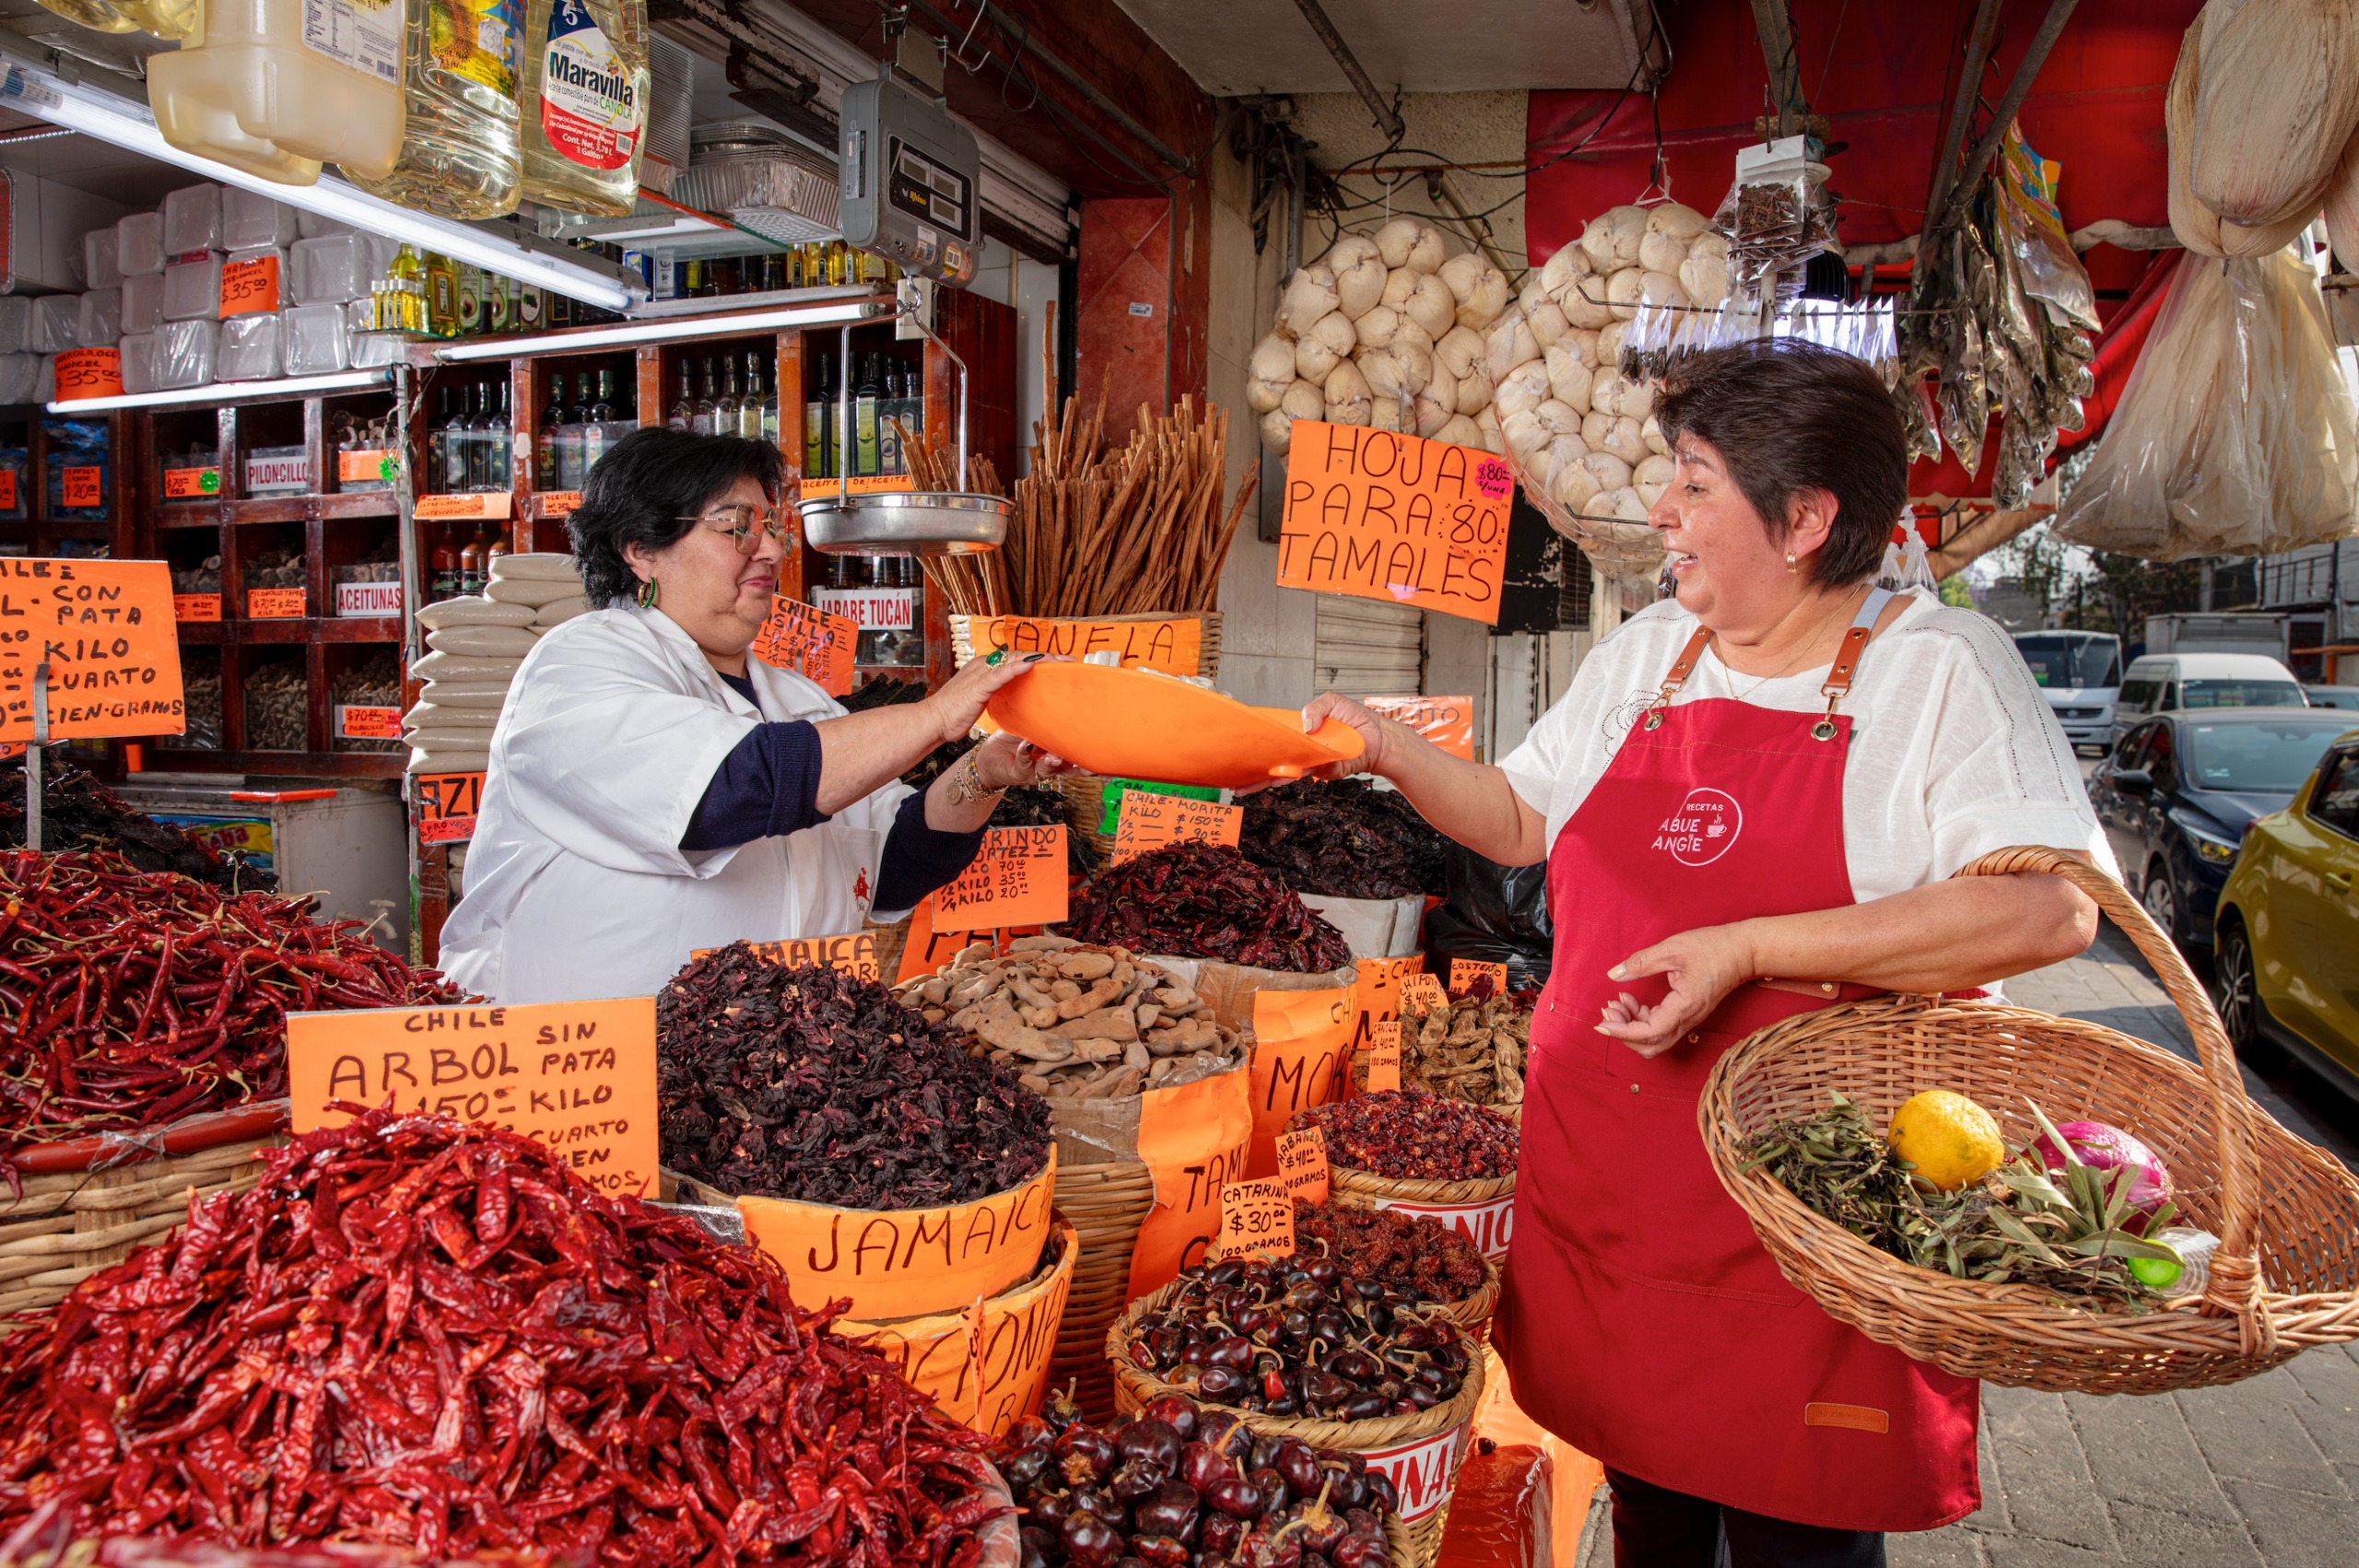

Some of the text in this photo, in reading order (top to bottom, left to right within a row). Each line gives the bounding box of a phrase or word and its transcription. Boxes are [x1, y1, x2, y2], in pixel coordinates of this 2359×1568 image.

[549, 51, 633, 107] Maravilla
[561, 86, 584, 101] comestible
[599, 97, 633, 121] CANOLA
[562, 133, 581, 146] Cont.
[581, 138, 594, 150] Net.
[910, 190, 927, 206] Rhino
[1326, 425, 1467, 499] HOJA
[1287, 481, 1497, 544] PARA 80
[1281, 531, 1493, 602] TAMALES
[53, 585, 121, 603] CON
[339, 586, 402, 611] ACEITUNAS
[57, 605, 142, 626] PATA
[778, 598, 832, 628] CHILE
[870, 591, 910, 626] TUCÁN
[44, 638, 129, 662] KILO
[989, 619, 1174, 663] CANELA
[1130, 805, 1161, 818] KILO
[1178, 800, 1233, 816] MORITA
[1686, 803, 1724, 812] RECETAS
[1659, 817, 1701, 832] ABUE
[1651, 833, 1703, 852] ANGIE
[958, 875, 991, 892] KILO
[958, 889, 994, 906] KILO
[1400, 974, 1446, 997] CHIPOTLE
[405, 1008, 507, 1033] CHILE
[536, 1022, 596, 1045] SIN
[328, 1042, 520, 1098] ARBOL
[541, 1047, 616, 1076] PATA
[529, 1083, 614, 1113] KILO
[1277, 1131, 1325, 1165] HABANERO
[1224, 1183, 1289, 1203] CATARINA
[808, 1172, 1053, 1276] JAMAICA
